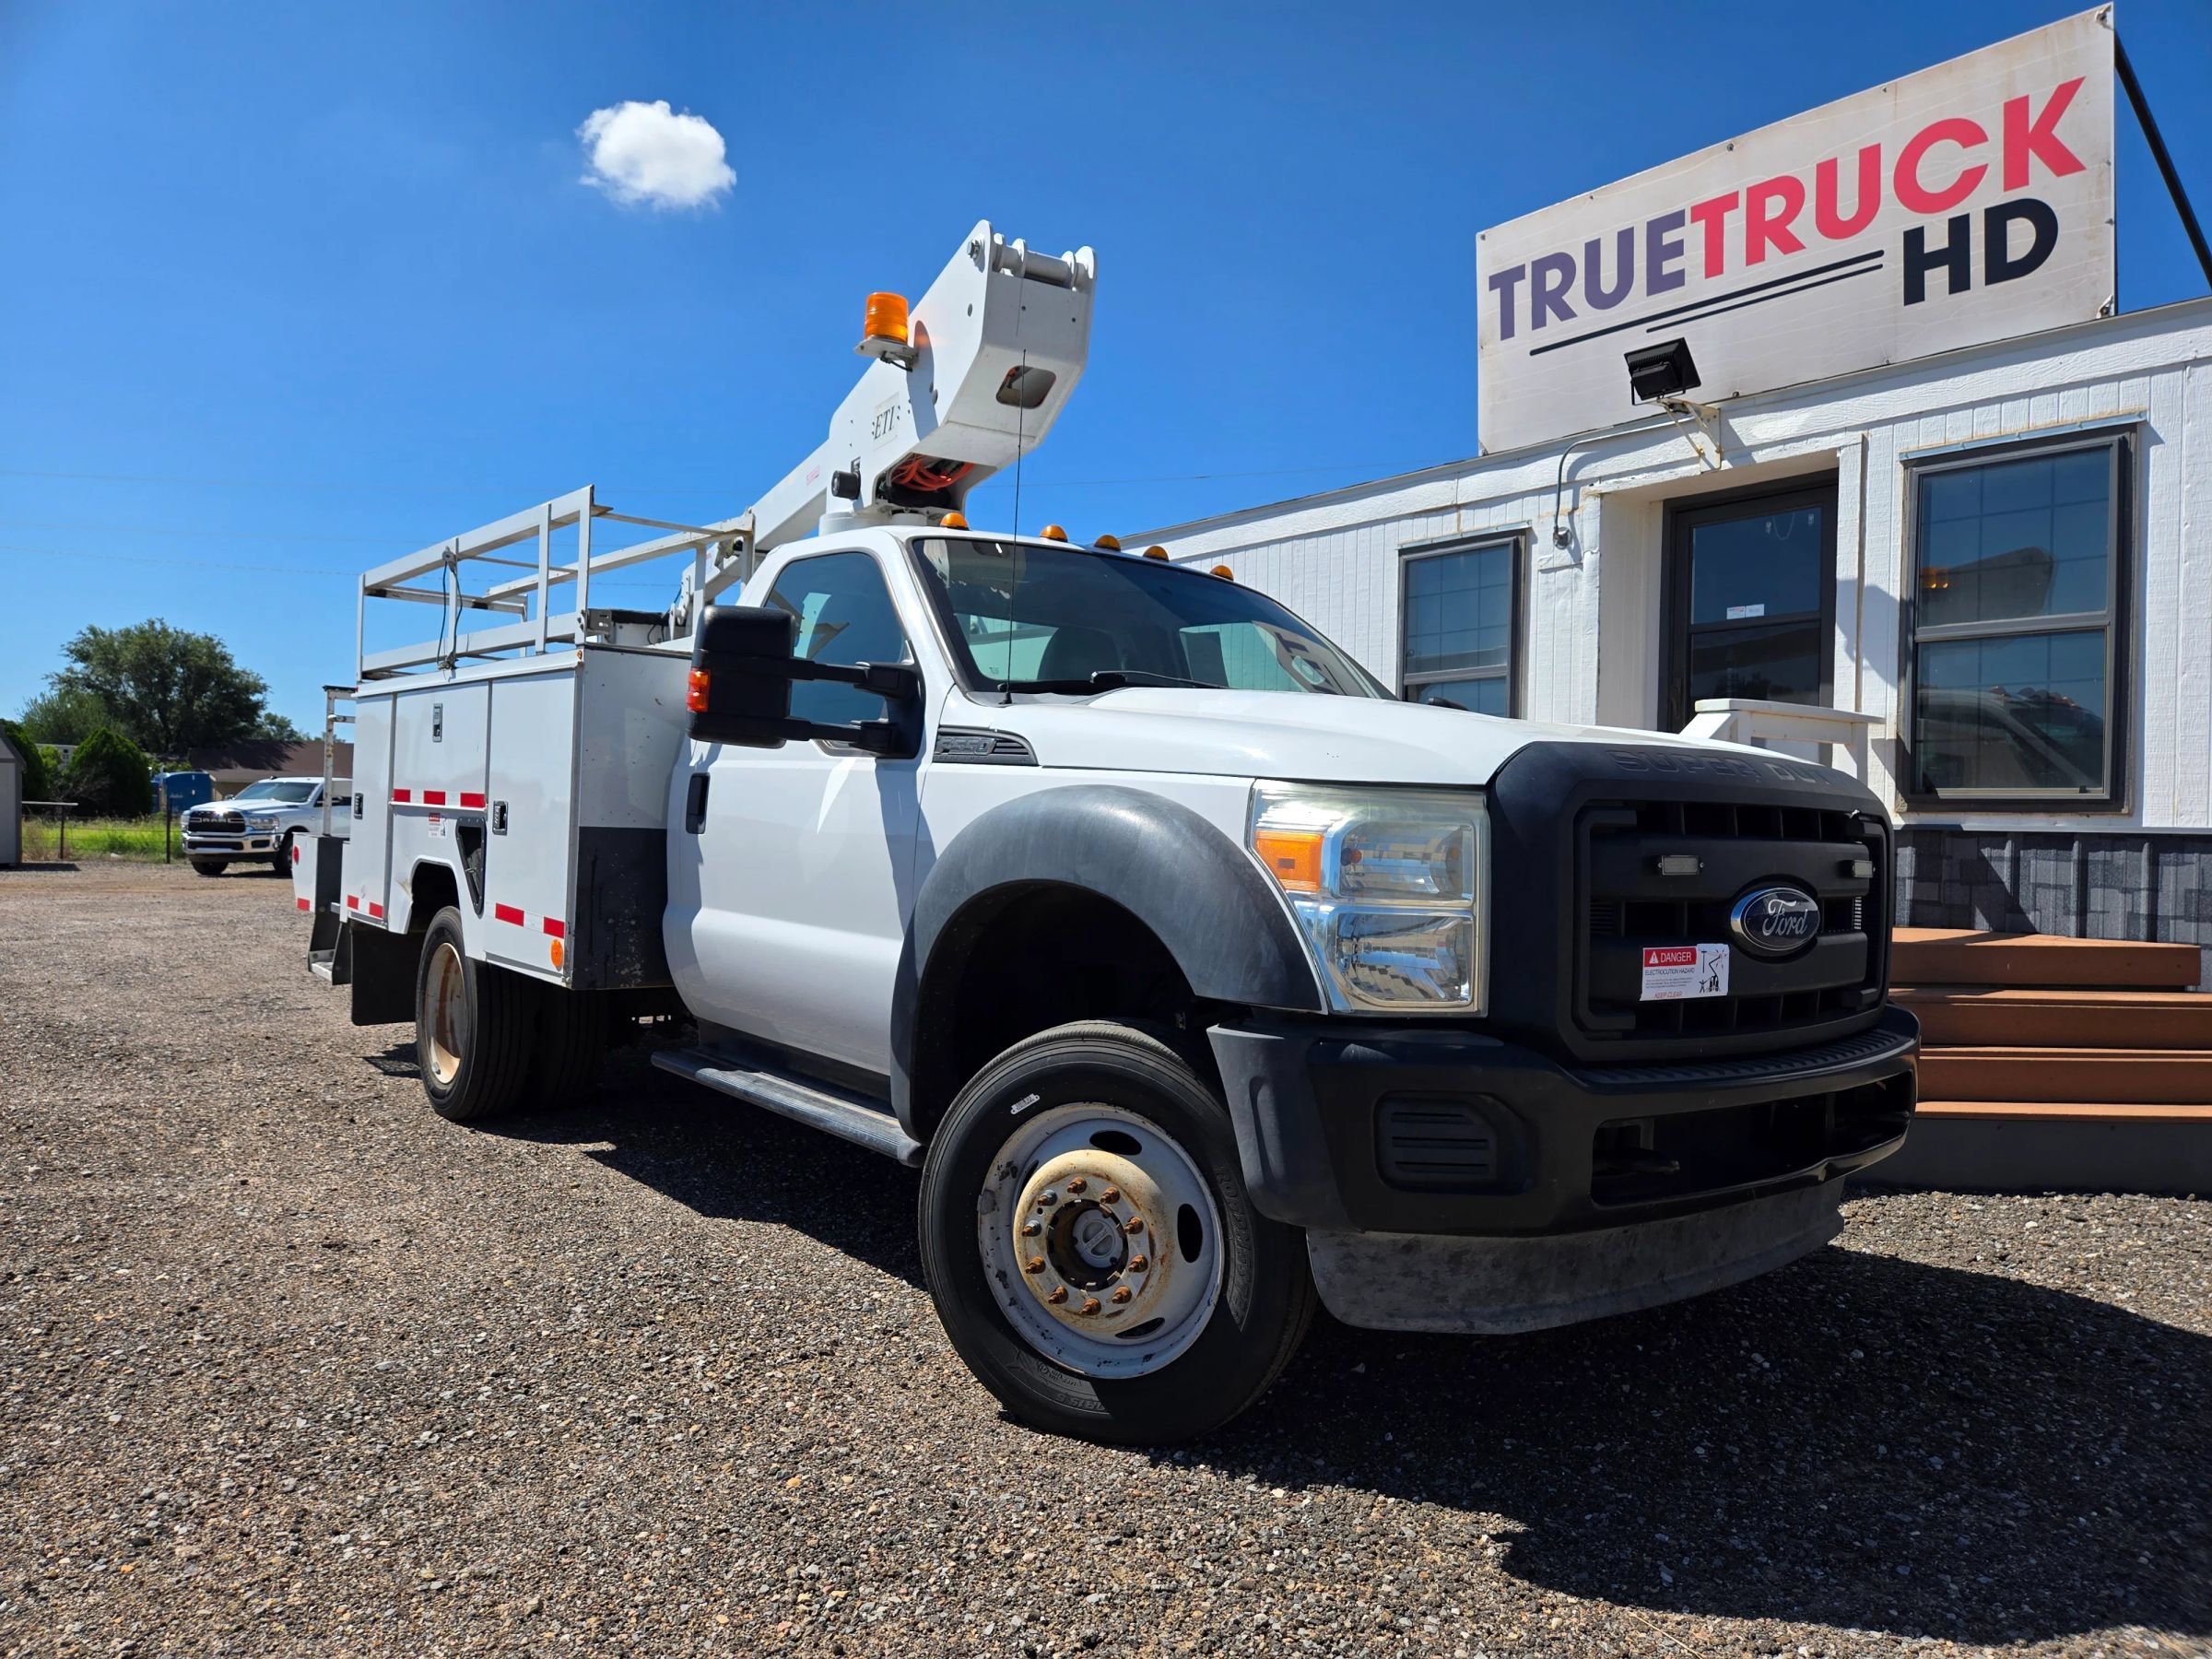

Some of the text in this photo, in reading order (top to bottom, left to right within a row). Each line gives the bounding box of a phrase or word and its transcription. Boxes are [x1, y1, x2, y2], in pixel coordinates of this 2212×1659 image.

[1488, 76, 2087, 341] TRUETRUCK
[1903, 198, 2058, 306] HD
[1607, 749, 1762, 778] SUPER
[1761, 899, 1808, 935] Ford
[1660, 951, 1691, 963] DANGER
